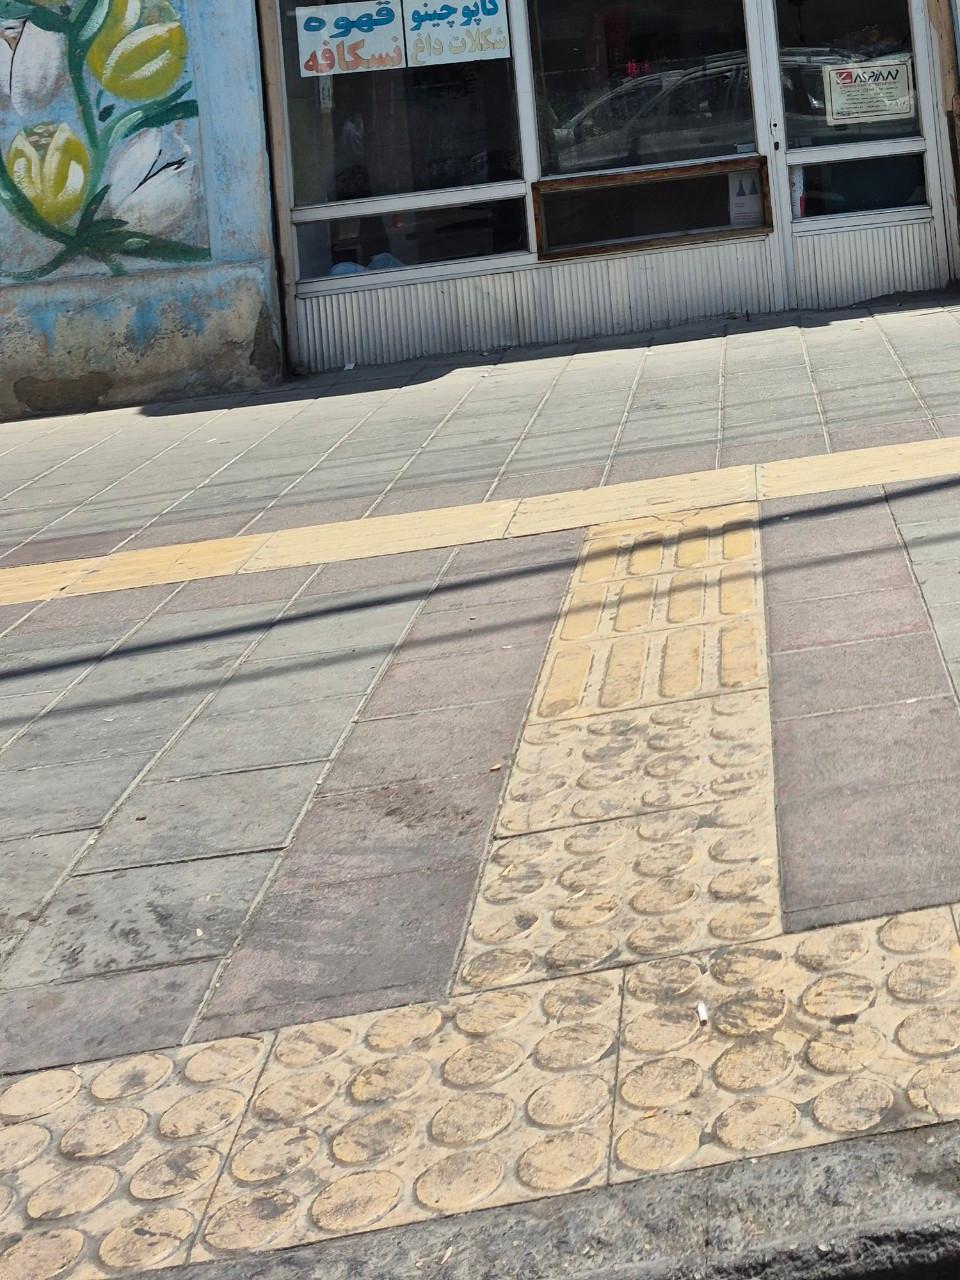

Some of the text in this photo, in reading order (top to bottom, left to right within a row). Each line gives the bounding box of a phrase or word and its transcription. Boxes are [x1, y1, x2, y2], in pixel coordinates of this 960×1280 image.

[303, 0, 396, 39] قهوه
[303, 27, 507, 73] شکلات داغ نسکافه
